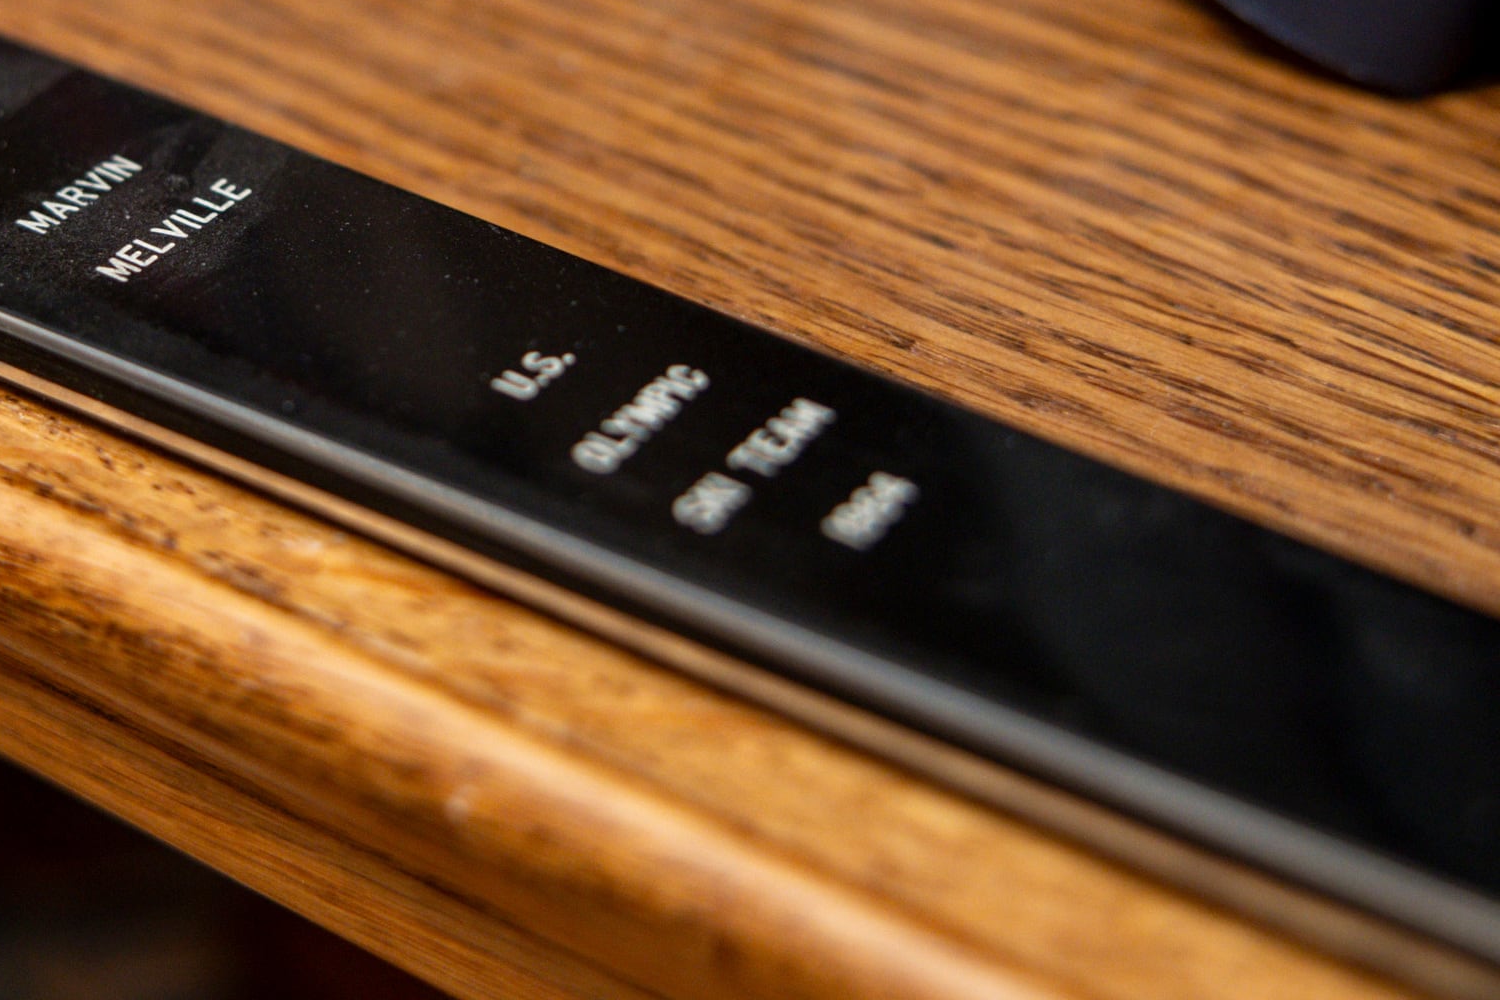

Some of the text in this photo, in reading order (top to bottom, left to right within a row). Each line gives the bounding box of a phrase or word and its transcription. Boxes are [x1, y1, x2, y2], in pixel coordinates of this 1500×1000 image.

[16, 154, 143, 235] MARVIN
[96, 178, 252, 282] MELVILLE
[490, 350, 577, 400] U.S.
[570, 363, 711, 475] OLYMPIC
[726, 397, 838, 478] TEAM
